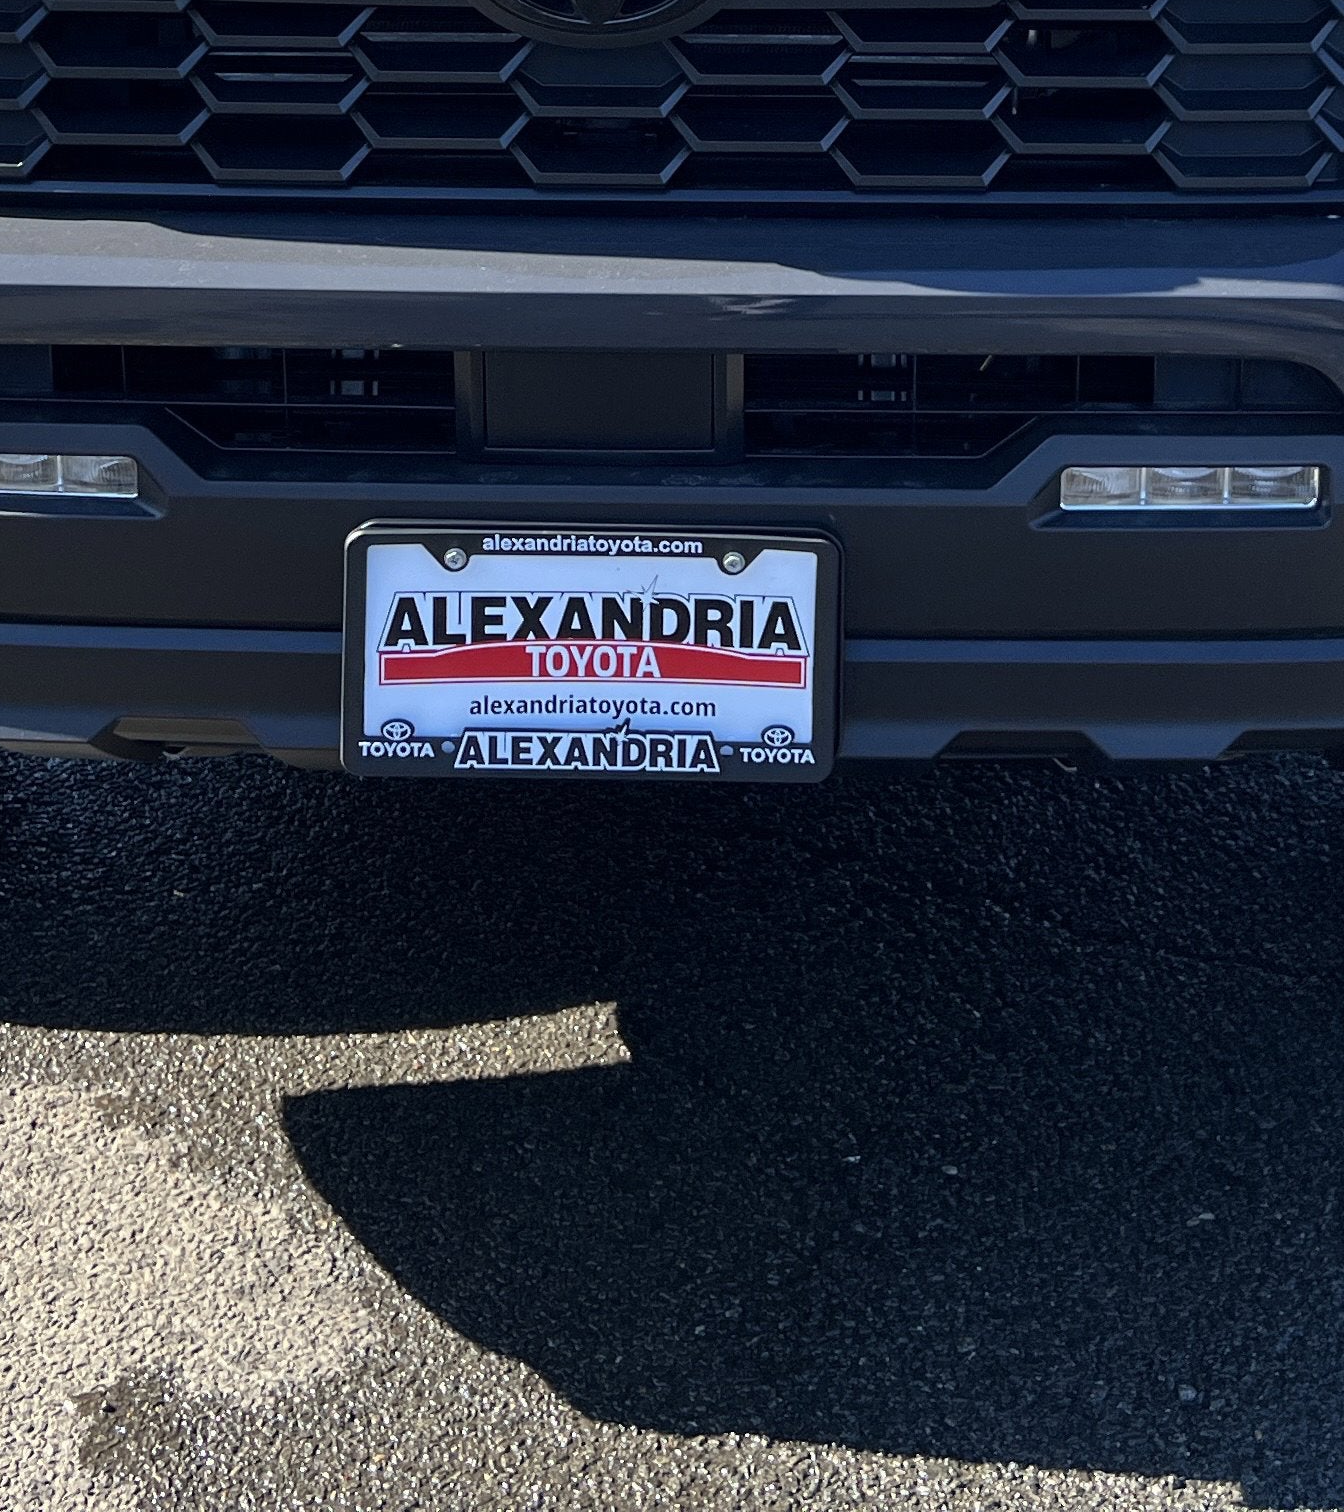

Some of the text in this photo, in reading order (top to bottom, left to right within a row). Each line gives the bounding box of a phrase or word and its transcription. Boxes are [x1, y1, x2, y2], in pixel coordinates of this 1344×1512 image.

[481, 533, 704, 556] alexandriatoyota.com
[383, 594, 804, 652] ALEXANDRIA
[524, 643, 662, 679] TOYOTA
[468, 694, 717, 719] alexandriatoyota.com
[358, 740, 435, 758] TOYOTA
[457, 732, 718, 771] ALEXANDRIA
[739, 746, 816, 765] TOYOTA
